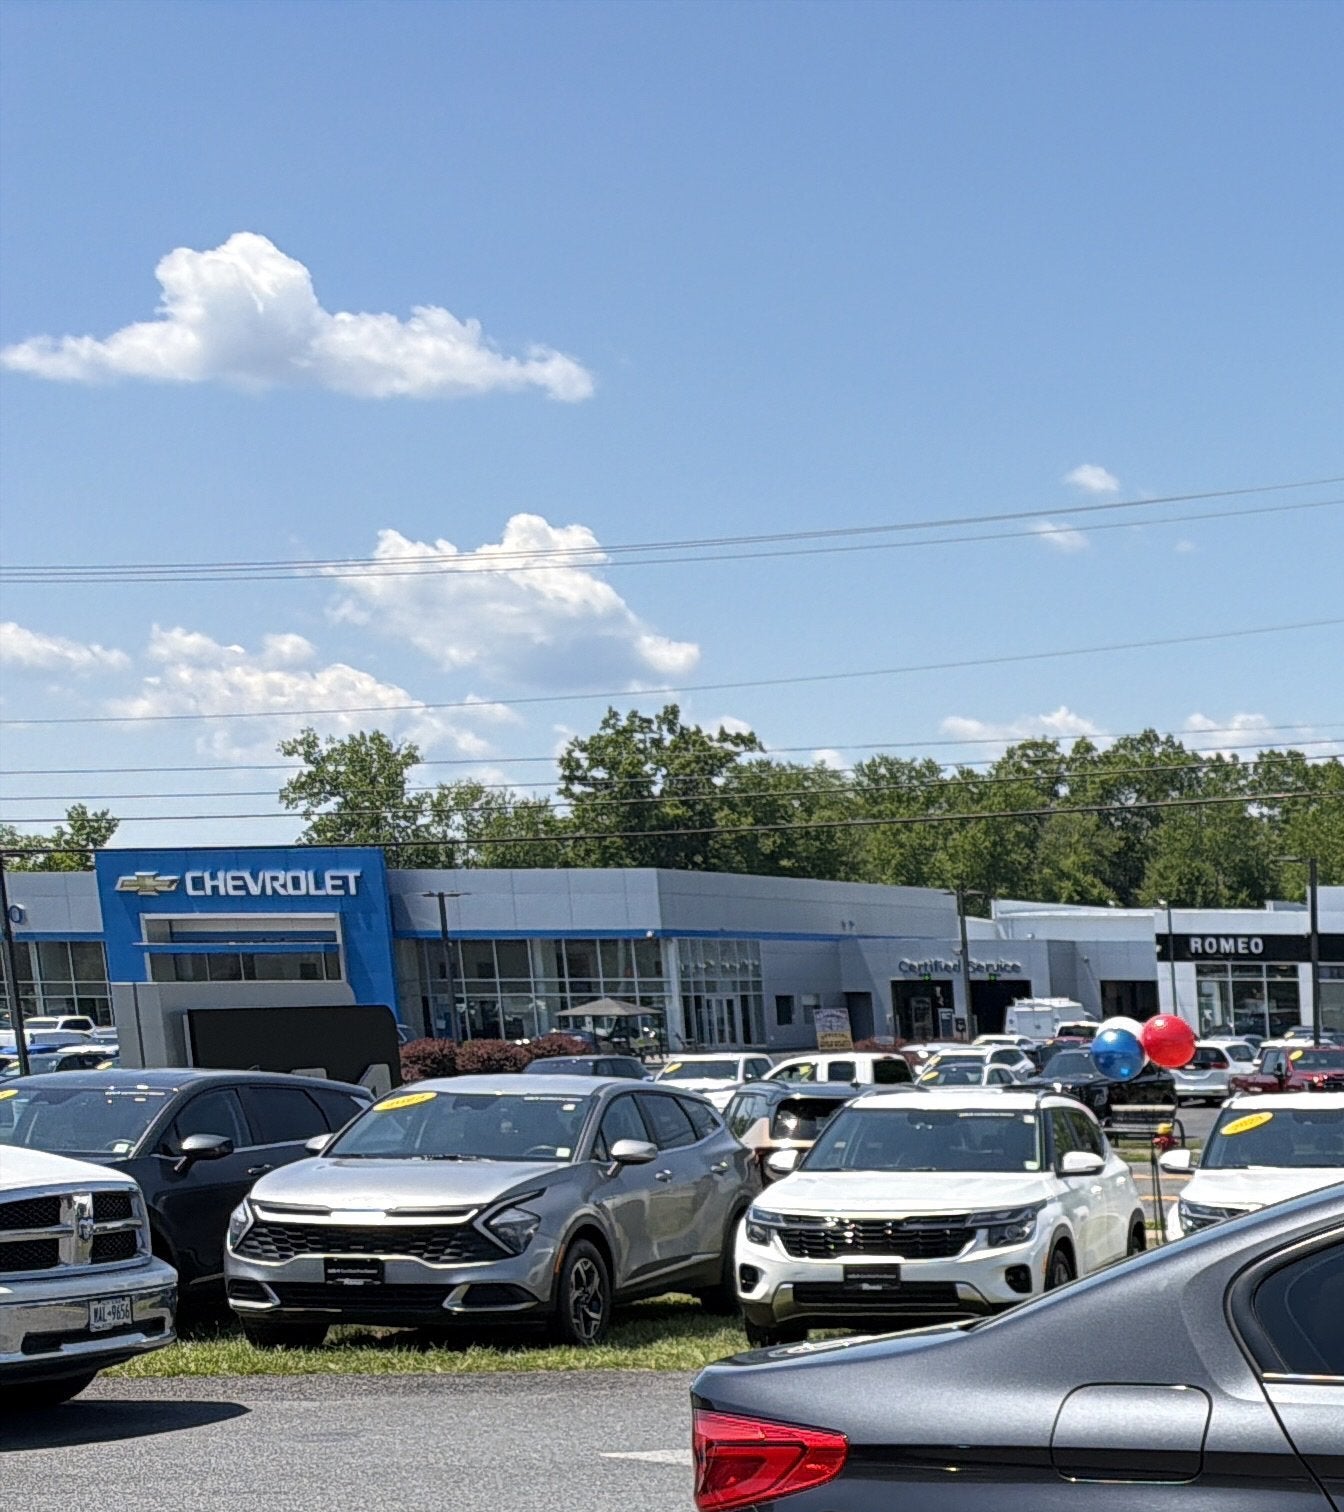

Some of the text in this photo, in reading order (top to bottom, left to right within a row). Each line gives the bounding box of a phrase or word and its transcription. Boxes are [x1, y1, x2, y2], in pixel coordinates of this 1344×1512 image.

[184, 870, 362, 896] CHEVROLET
[1190, 937, 1264, 954] ROMEO
[898, 959, 1021, 974] Certified Service
